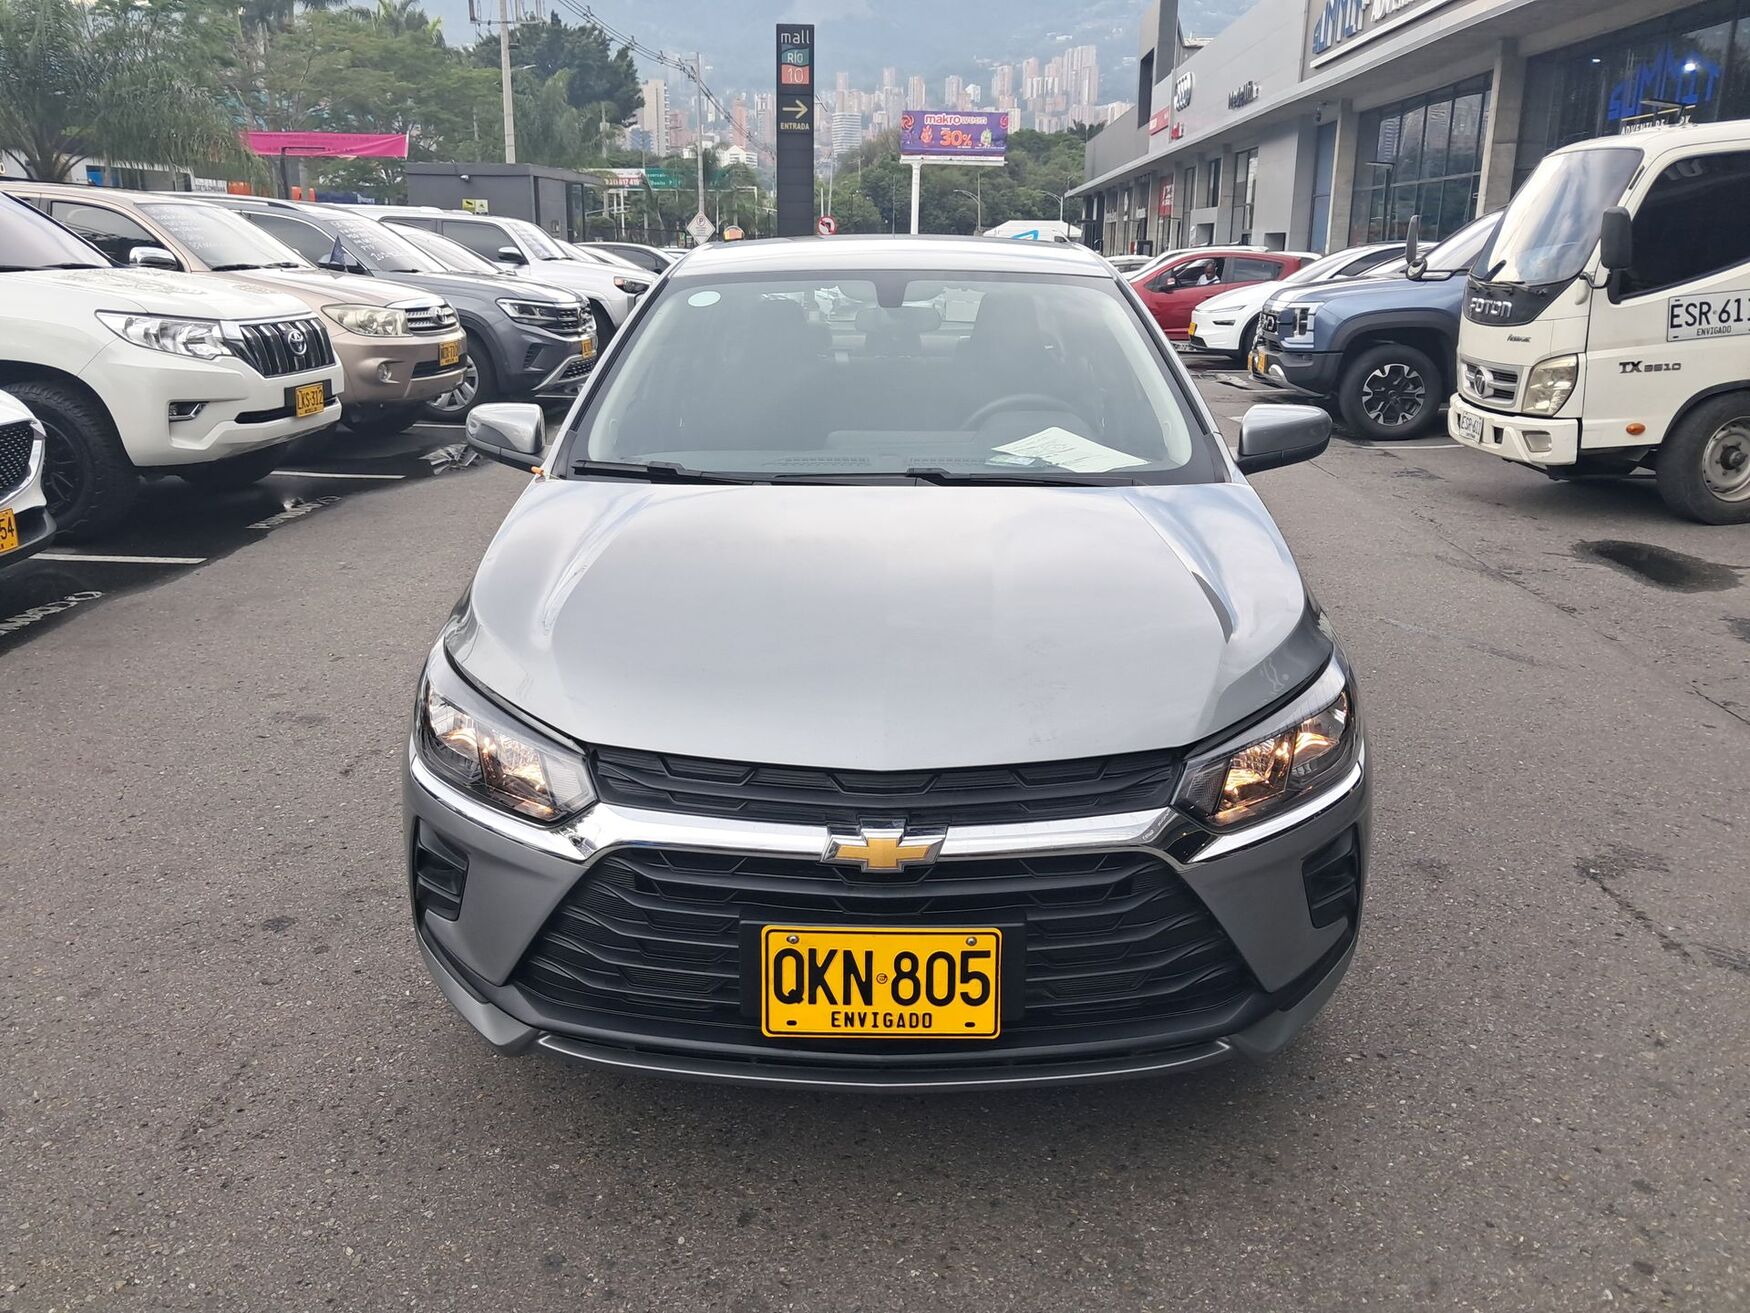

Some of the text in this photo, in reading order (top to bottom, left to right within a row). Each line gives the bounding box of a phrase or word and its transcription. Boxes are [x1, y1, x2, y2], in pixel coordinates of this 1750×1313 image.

[780, 29, 810, 44] mall
[788, 68, 804, 83] 10
[780, 122, 810, 131] ENTRADA
[940, 130, 973, 147] 30%
[1470, 297, 1513, 319] FOTON
[1696, 325, 1732, 337] ENVIGADO
[831, 1010, 933, 1029] ENVIGADO
